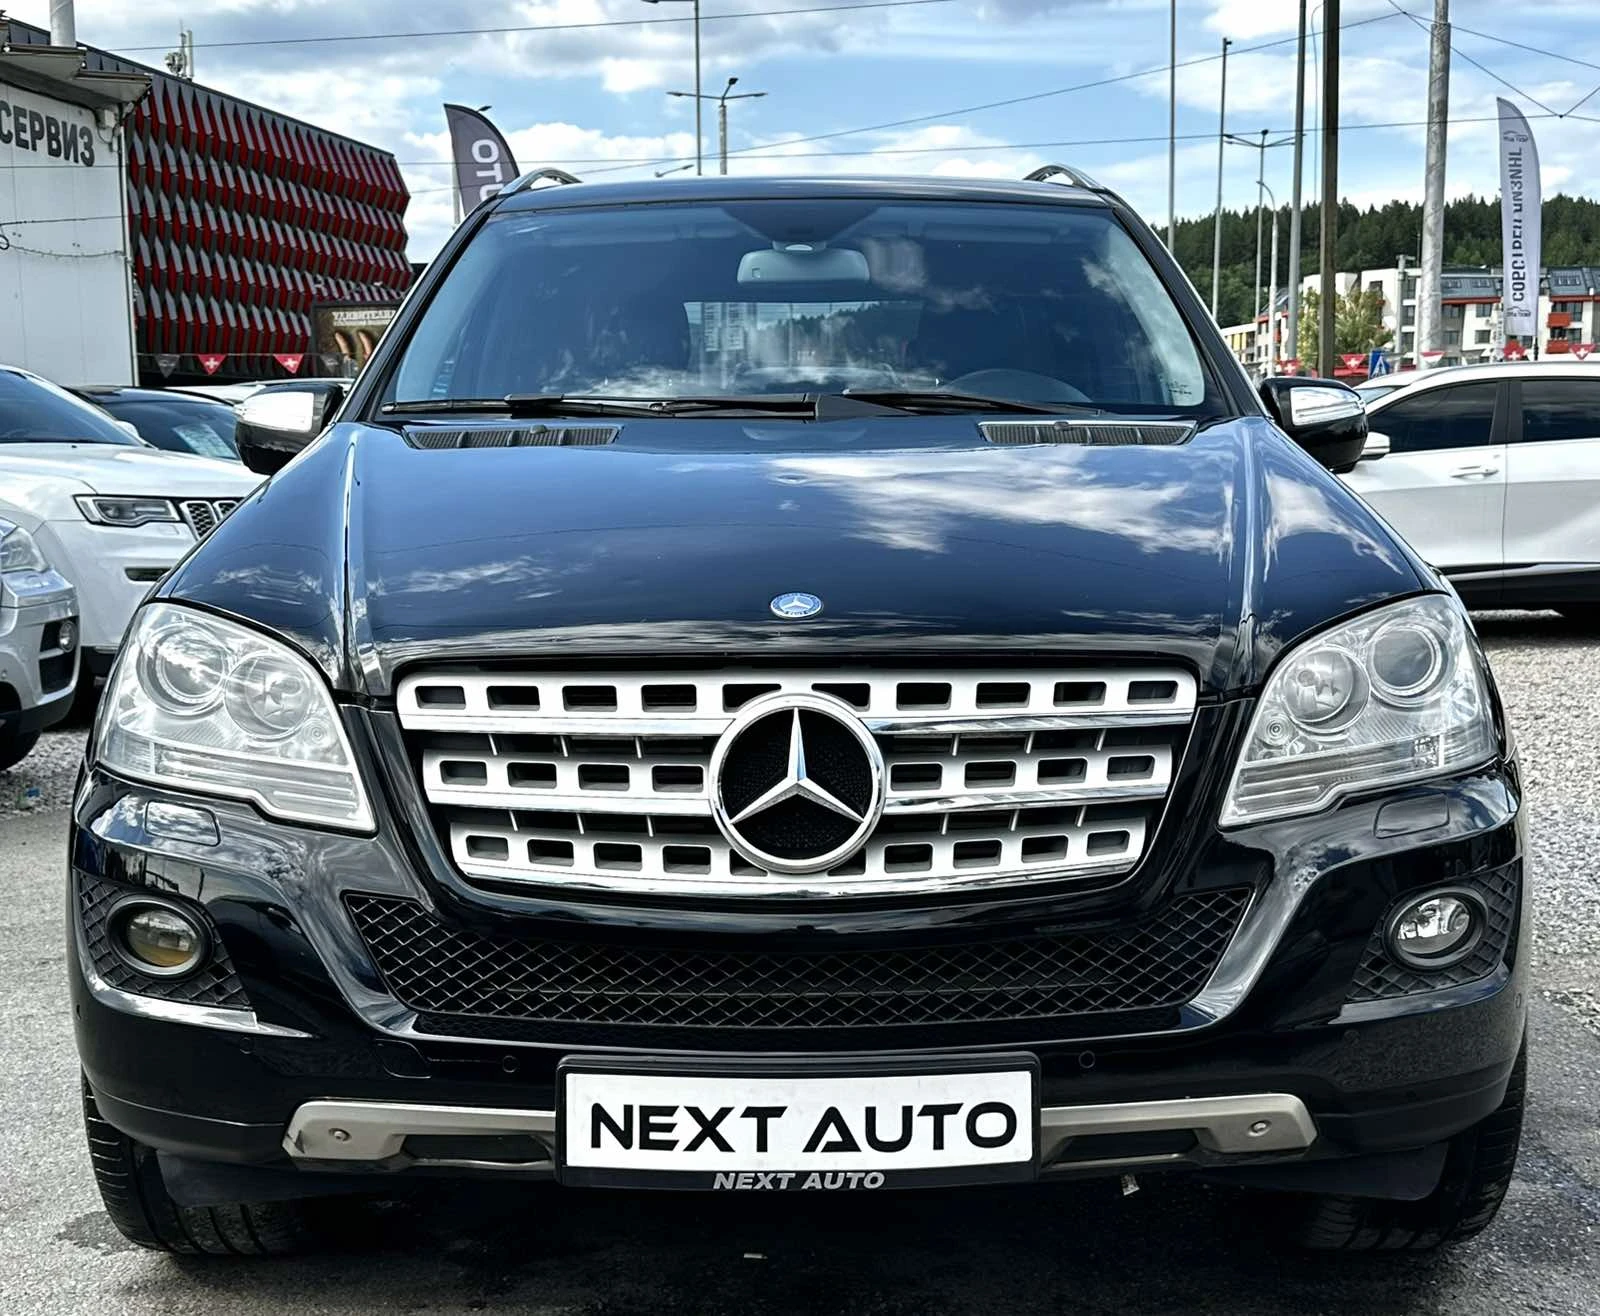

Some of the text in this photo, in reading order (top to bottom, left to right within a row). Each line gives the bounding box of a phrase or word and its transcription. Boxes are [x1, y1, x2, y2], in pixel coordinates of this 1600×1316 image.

[0, 100, 95, 167] СЕРВИЗ
[590, 1101, 1017, 1153] NEXT AUTO
[713, 1171, 885, 1189] NEXT AUTO
